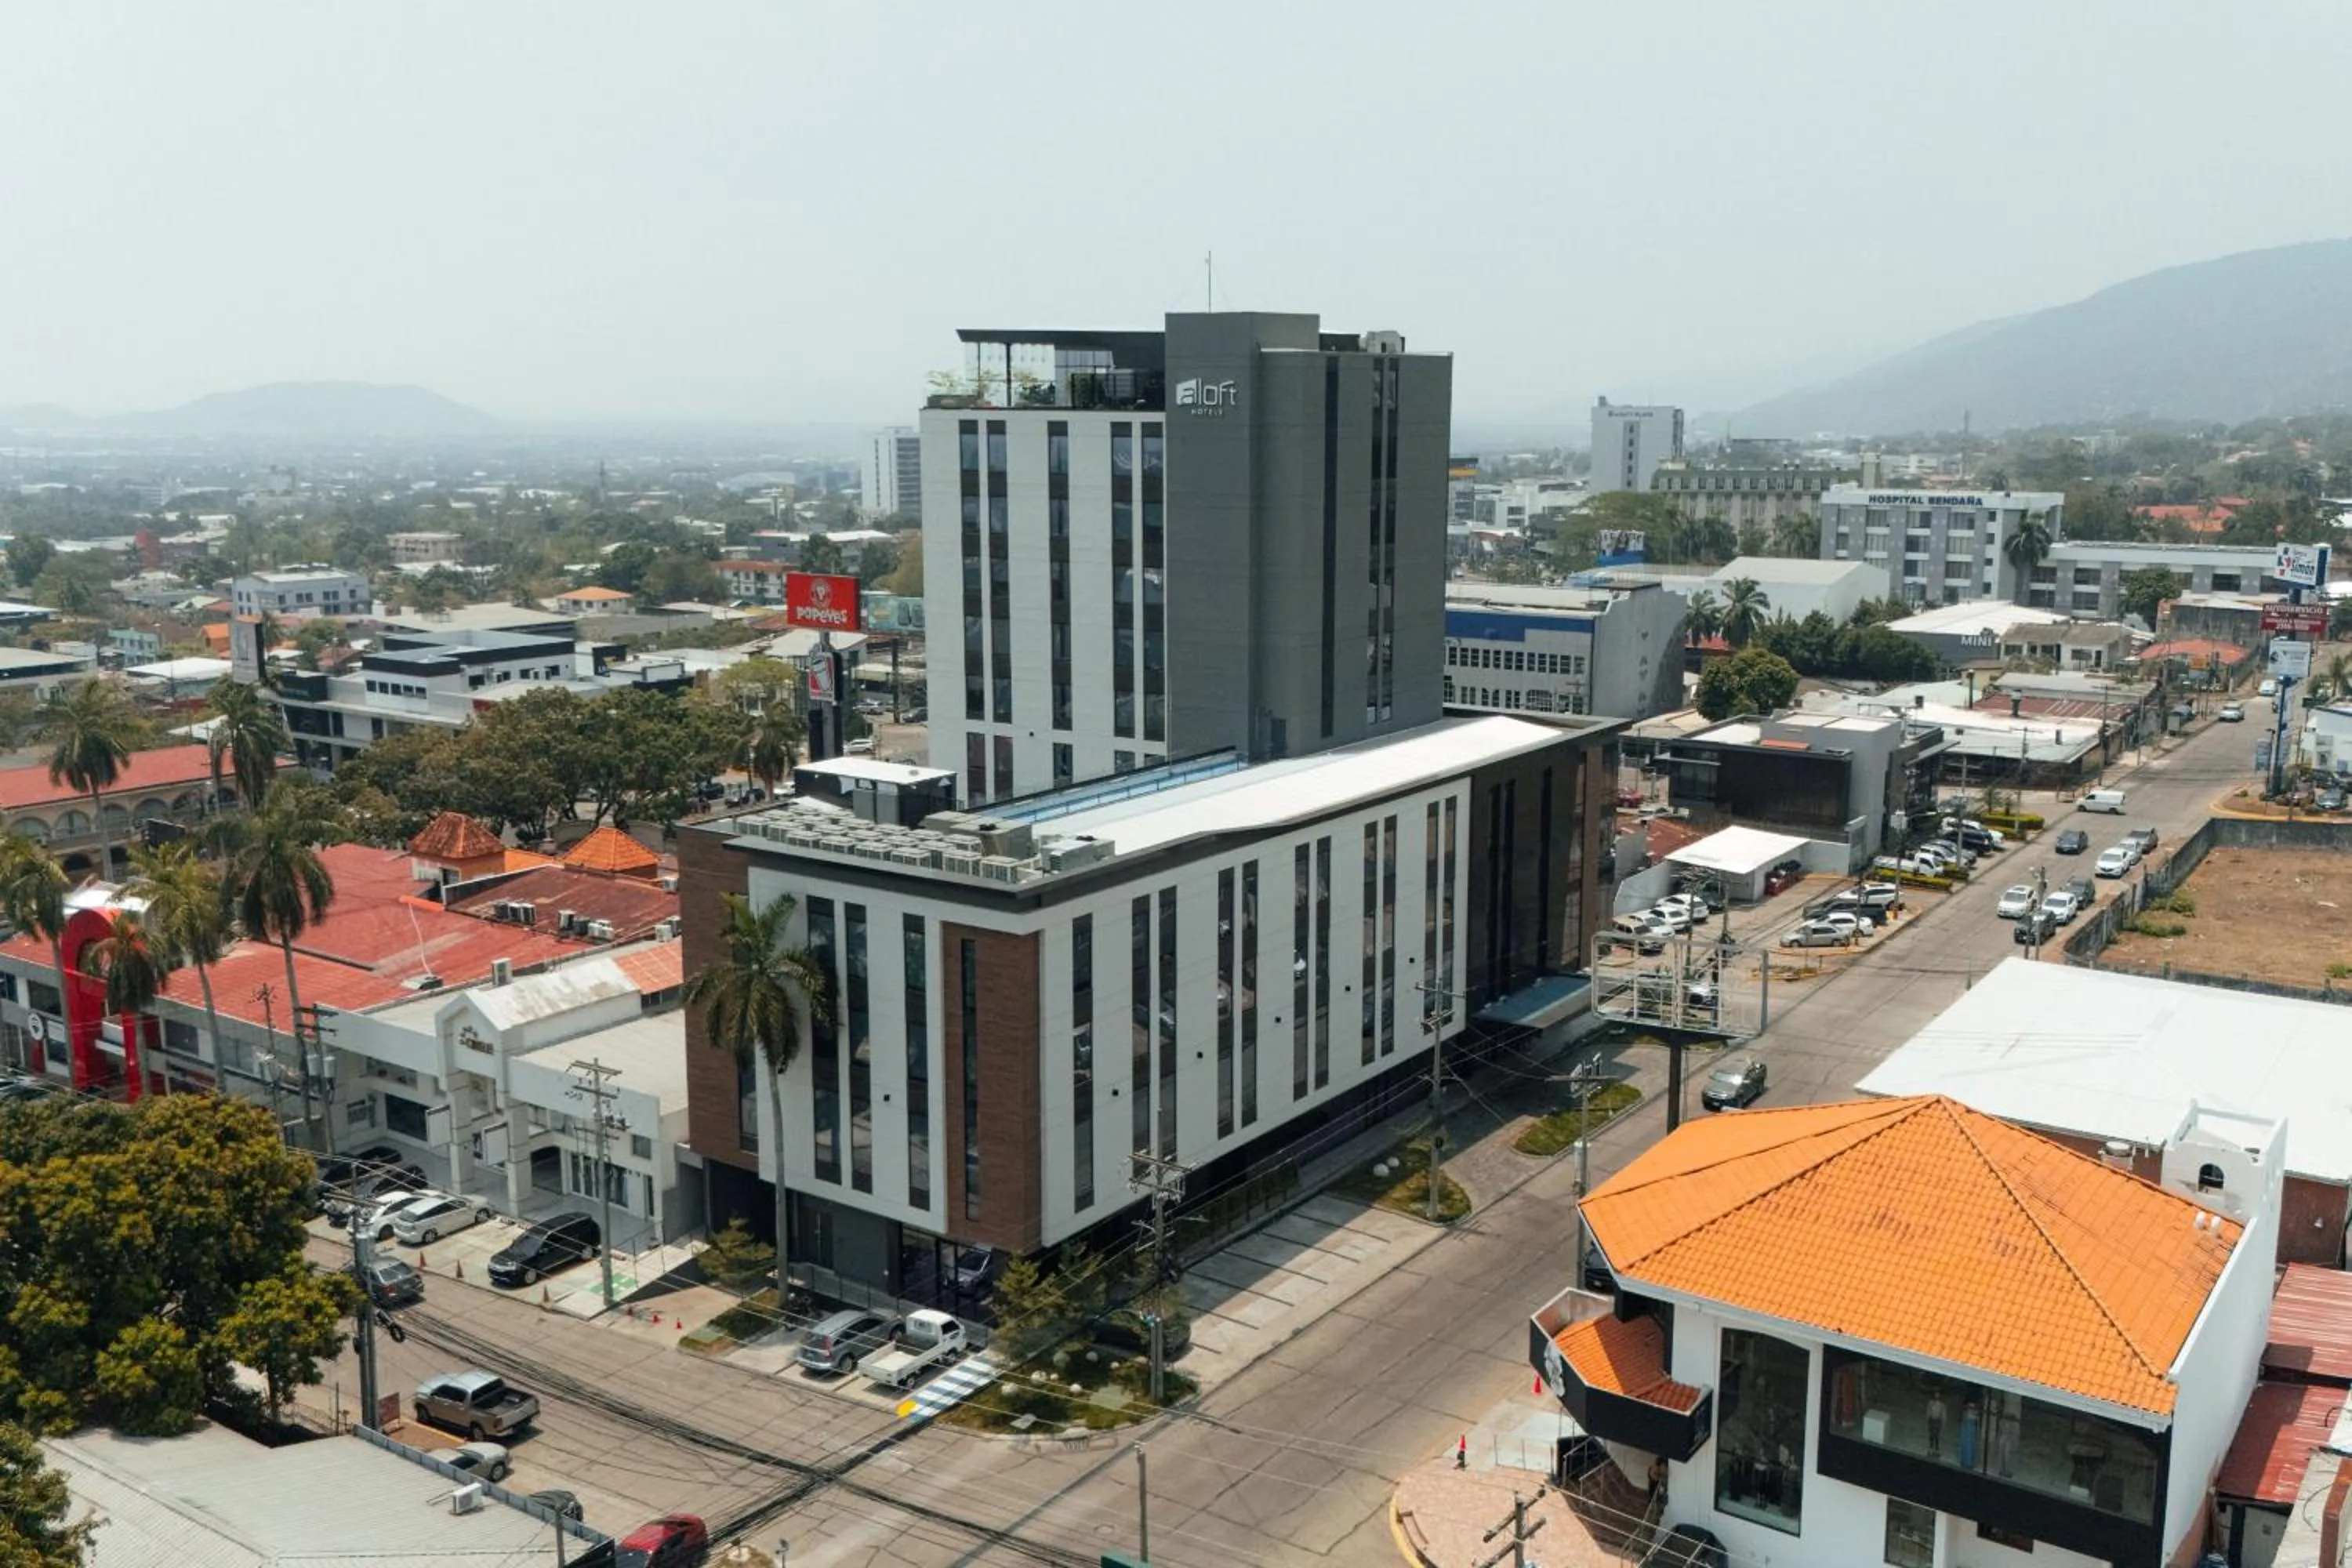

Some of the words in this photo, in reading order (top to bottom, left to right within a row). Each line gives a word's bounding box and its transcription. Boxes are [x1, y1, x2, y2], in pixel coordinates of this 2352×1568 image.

[1176, 377, 1236, 405] aloft
[1868, 495, 1924, 505] HOSPITAL
[1928, 495, 1984, 506] BENDAÑA
[1961, 636, 1992, 647] MINI
